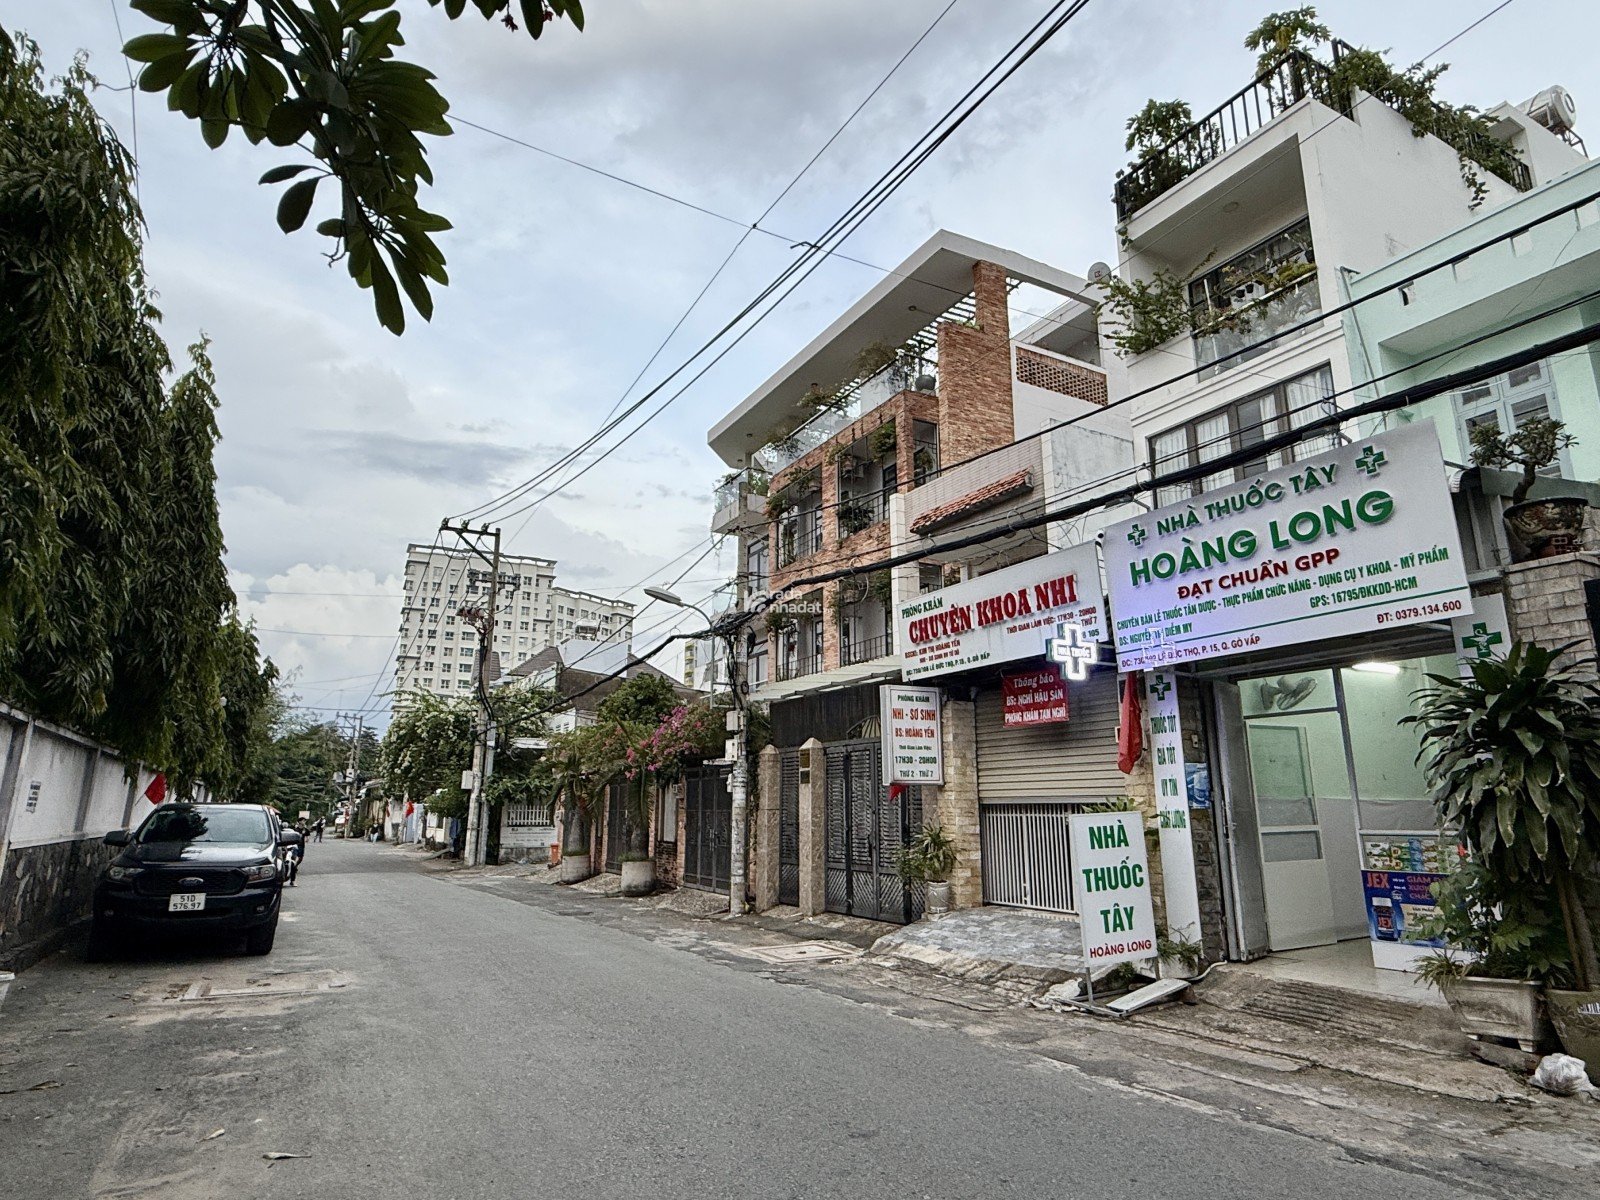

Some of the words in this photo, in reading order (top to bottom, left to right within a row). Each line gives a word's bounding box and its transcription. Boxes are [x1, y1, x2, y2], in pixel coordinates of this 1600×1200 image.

[1157, 505, 1200, 535] NHÀ
[1204, 479, 1284, 520] THUỐC
[1289, 464, 1336, 494] TÂY
[1129, 529, 1257, 587] HOÀNG
[1269, 490, 1394, 550] LONG
[1177, 579, 1213, 600] ĐẠT
[1218, 560, 1288, 589] CHUẨN
[1294, 548, 1341, 571] GPP
[1116, 617, 1140, 631] CHUYÊN
[1140, 614, 1153, 626] BÁN
[1154, 612, 1162, 624] LẺ
[1162, 606, 1183, 621] THUỐC
[1184, 604, 1197, 616] TÂN
[1198, 600, 1217, 614] DƯỢC
[1223, 595, 1241, 609] THỰC
[1242, 588, 1264, 603] PHẨM
[1266, 583, 1287, 598] CHỨC
[1288, 578, 1312, 594] NĂNG
[1318, 571, 1343, 588] DỤNG
[1344, 569, 1356, 582] CỤ
[1358, 567, 1364, 578] Y
[1366, 561, 1392, 576] KHOA
[1400, 552, 1415, 570] MỸ
[1418, 545, 1449, 566] PHẨM
[902, 602, 923, 619] PHÒNG
[923, 597, 944, 613] KHÁM
[908, 604, 973, 644] CHUYÊN
[975, 588, 1033, 627] KHOA
[1034, 574, 1078, 612] NHI
[1310, 595, 1330, 608] GPS:
[1377, 612, 1393, 624] ĐT:
[1395, 600, 1462, 620] 0379.134.600
[1119, 636, 1130, 646] BS:
[1122, 658, 1133, 668] ĐC:
[1184, 646, 1201, 657] THỌ,
[1202, 646, 1209, 654] P.
[1210, 644, 1220, 652] 15,
[1221, 642, 1230, 650] Q.
[1230, 637, 1243, 649] GÒ
[1244, 633, 1260, 646] VẤP
[1014, 676, 1038, 688] Thông
[1039, 672, 1054, 684] báo
[1006, 696, 1016, 706] BS:
[1018, 690, 1034, 705] NGHỈ
[1034, 688, 1048, 704] HẬU
[892, 708, 904, 720] NHI
[910, 708, 919, 720] SƠ
[920, 710, 936, 722] SINH
[1166, 708, 1176, 732] TỐT
[895, 728, 904, 738] BS:
[905, 726, 922, 738] HOÀNG
[924, 726, 935, 738] YẾN
[895, 756, 914, 764] 17H30
[910, 770, 914, 778] 2
[1088, 820, 1130, 850] NHÀ
[1082, 856, 1144, 893] THUỐC
[1366, 872, 1390, 889] JEX
[180, 894, 196, 902] 51D
[1100, 902, 1134, 934] TÂY
[1090, 942, 1124, 958] HOÀNG
[1126, 940, 1152, 953] LONG
